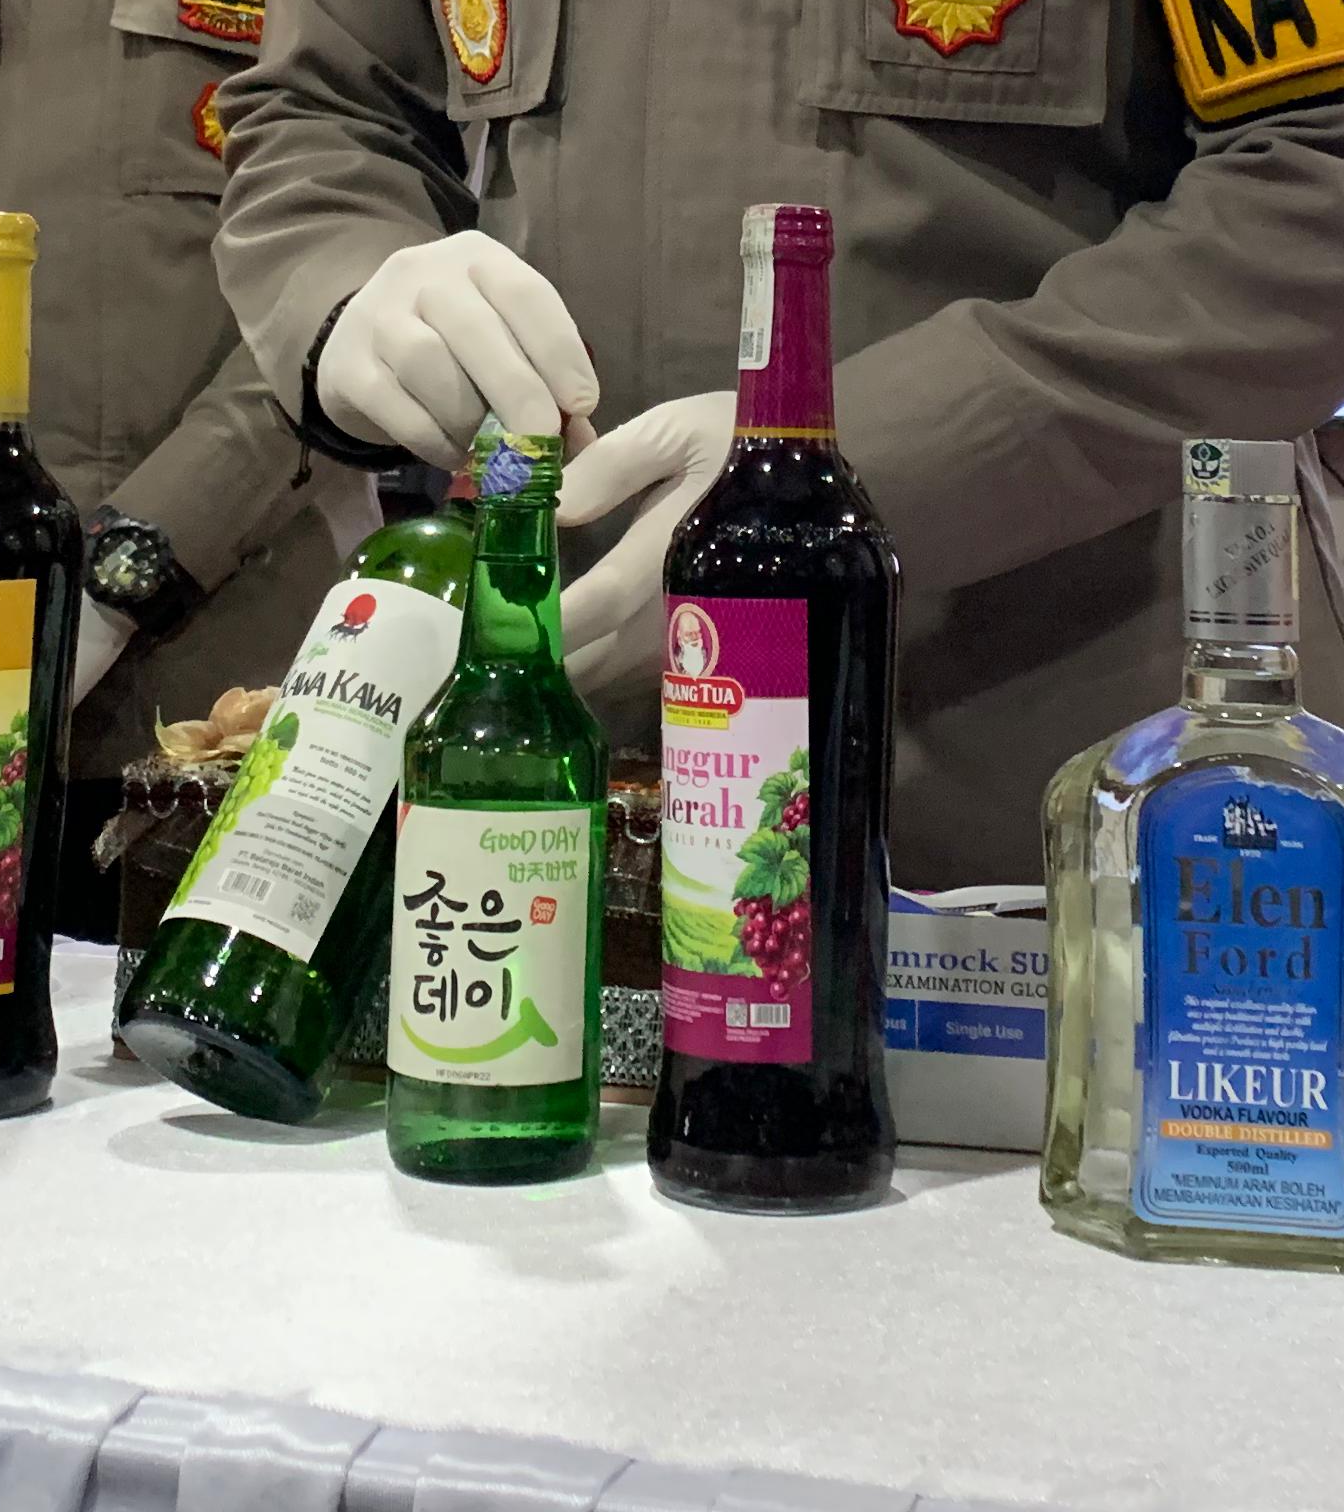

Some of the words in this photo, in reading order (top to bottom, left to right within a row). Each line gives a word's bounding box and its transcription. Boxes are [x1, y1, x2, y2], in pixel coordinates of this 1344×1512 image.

[327, 669, 402, 725] KAWA
[699, 683, 736, 705] TUA
[542, 826, 581, 852] DAY
[705, 836, 733, 850] PAS
[1173, 856, 1327, 928] Elen
[403, 870, 522, 967] 좋은
[533, 910, 552, 921] DAY
[890, 949, 998, 974] mrock
[1182, 930, 1313, 979] Ford
[413, 968, 513, 1022] 데이
[886, 974, 1005, 995] EXAMINATION
[946, 1021, 992, 1040] Single
[996, 1025, 1024, 1039] Use
[1168, 1059, 1329, 1111] LIKEUR
[1180, 1104, 1234, 1122] VODKA
[1239, 1108, 1309, 1128] FLAVOUR
[1168, 1123, 1234, 1139] DOUBLE
[1240, 1127, 1327, 1147] DISTILLED
[1196, 1143, 1249, 1159] Exported
[1256, 1147, 1298, 1164] Quality
[1154, 1188, 1262, 1209] MEMBAHAYAKAN
[1242, 1177, 1276, 1194] ARAK
[1280, 1180, 1325, 1198] BOLEH
